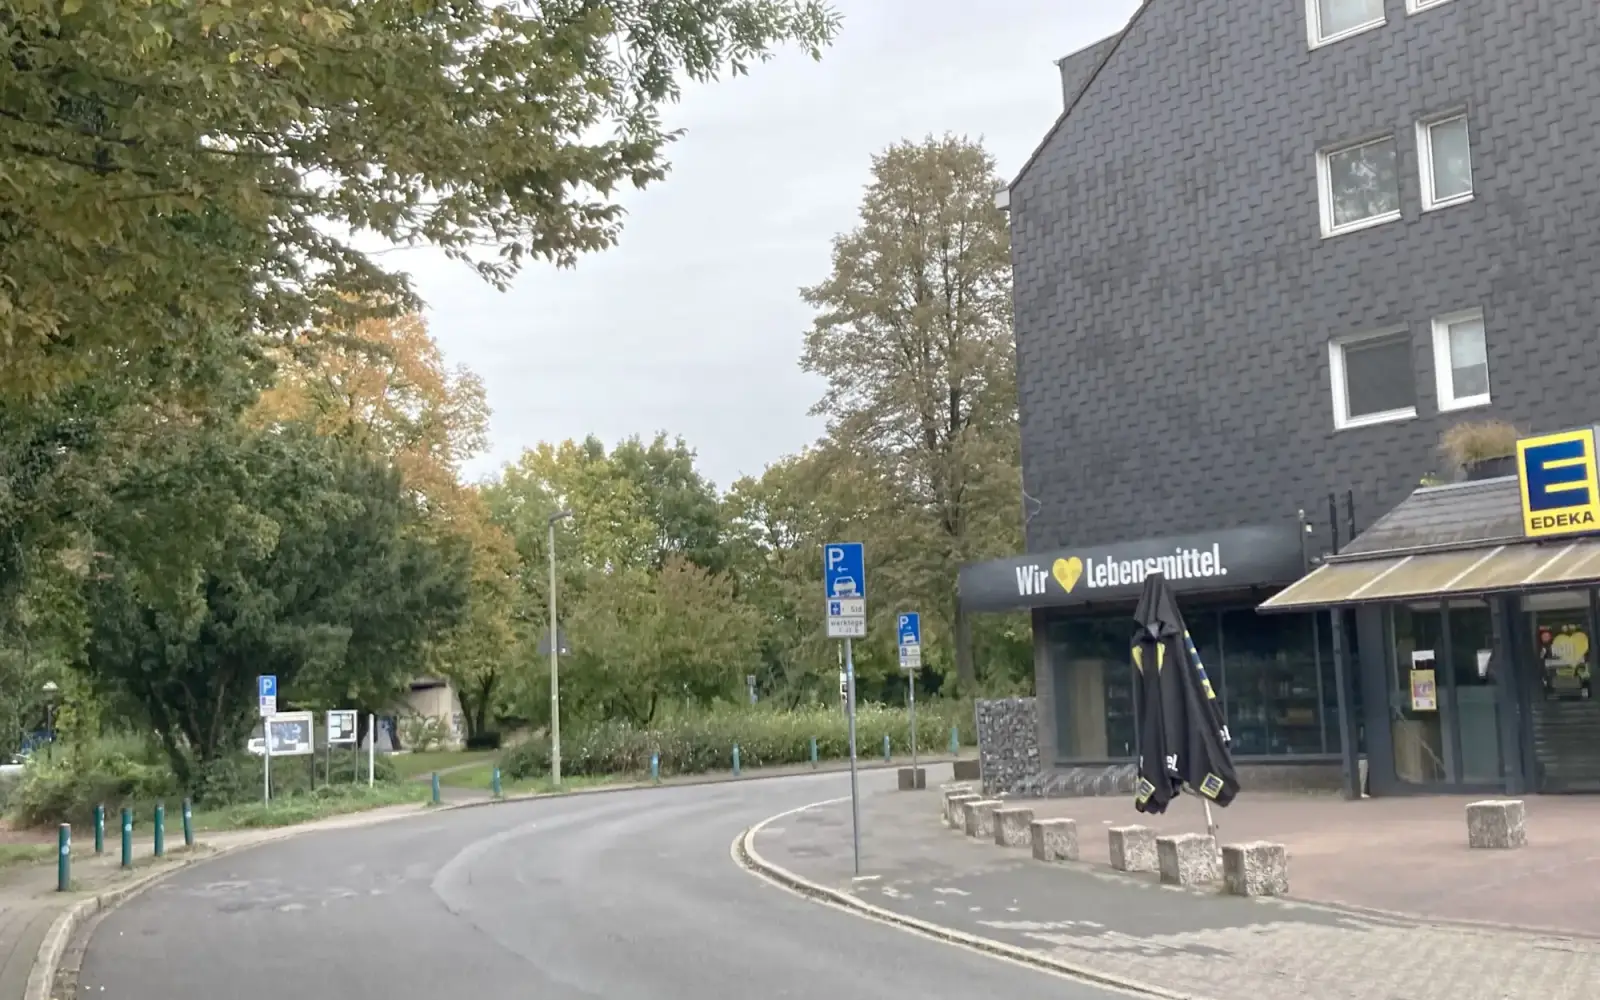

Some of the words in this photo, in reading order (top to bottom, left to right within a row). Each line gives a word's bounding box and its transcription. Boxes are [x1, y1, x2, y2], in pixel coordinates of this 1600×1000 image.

[1531, 511, 1595, 530] EDEKA
[828, 548, 844, 571] P
[1016, 565, 1049, 596] Wir
[900, 616, 909, 630] P
[264, 680, 273, 694] P
